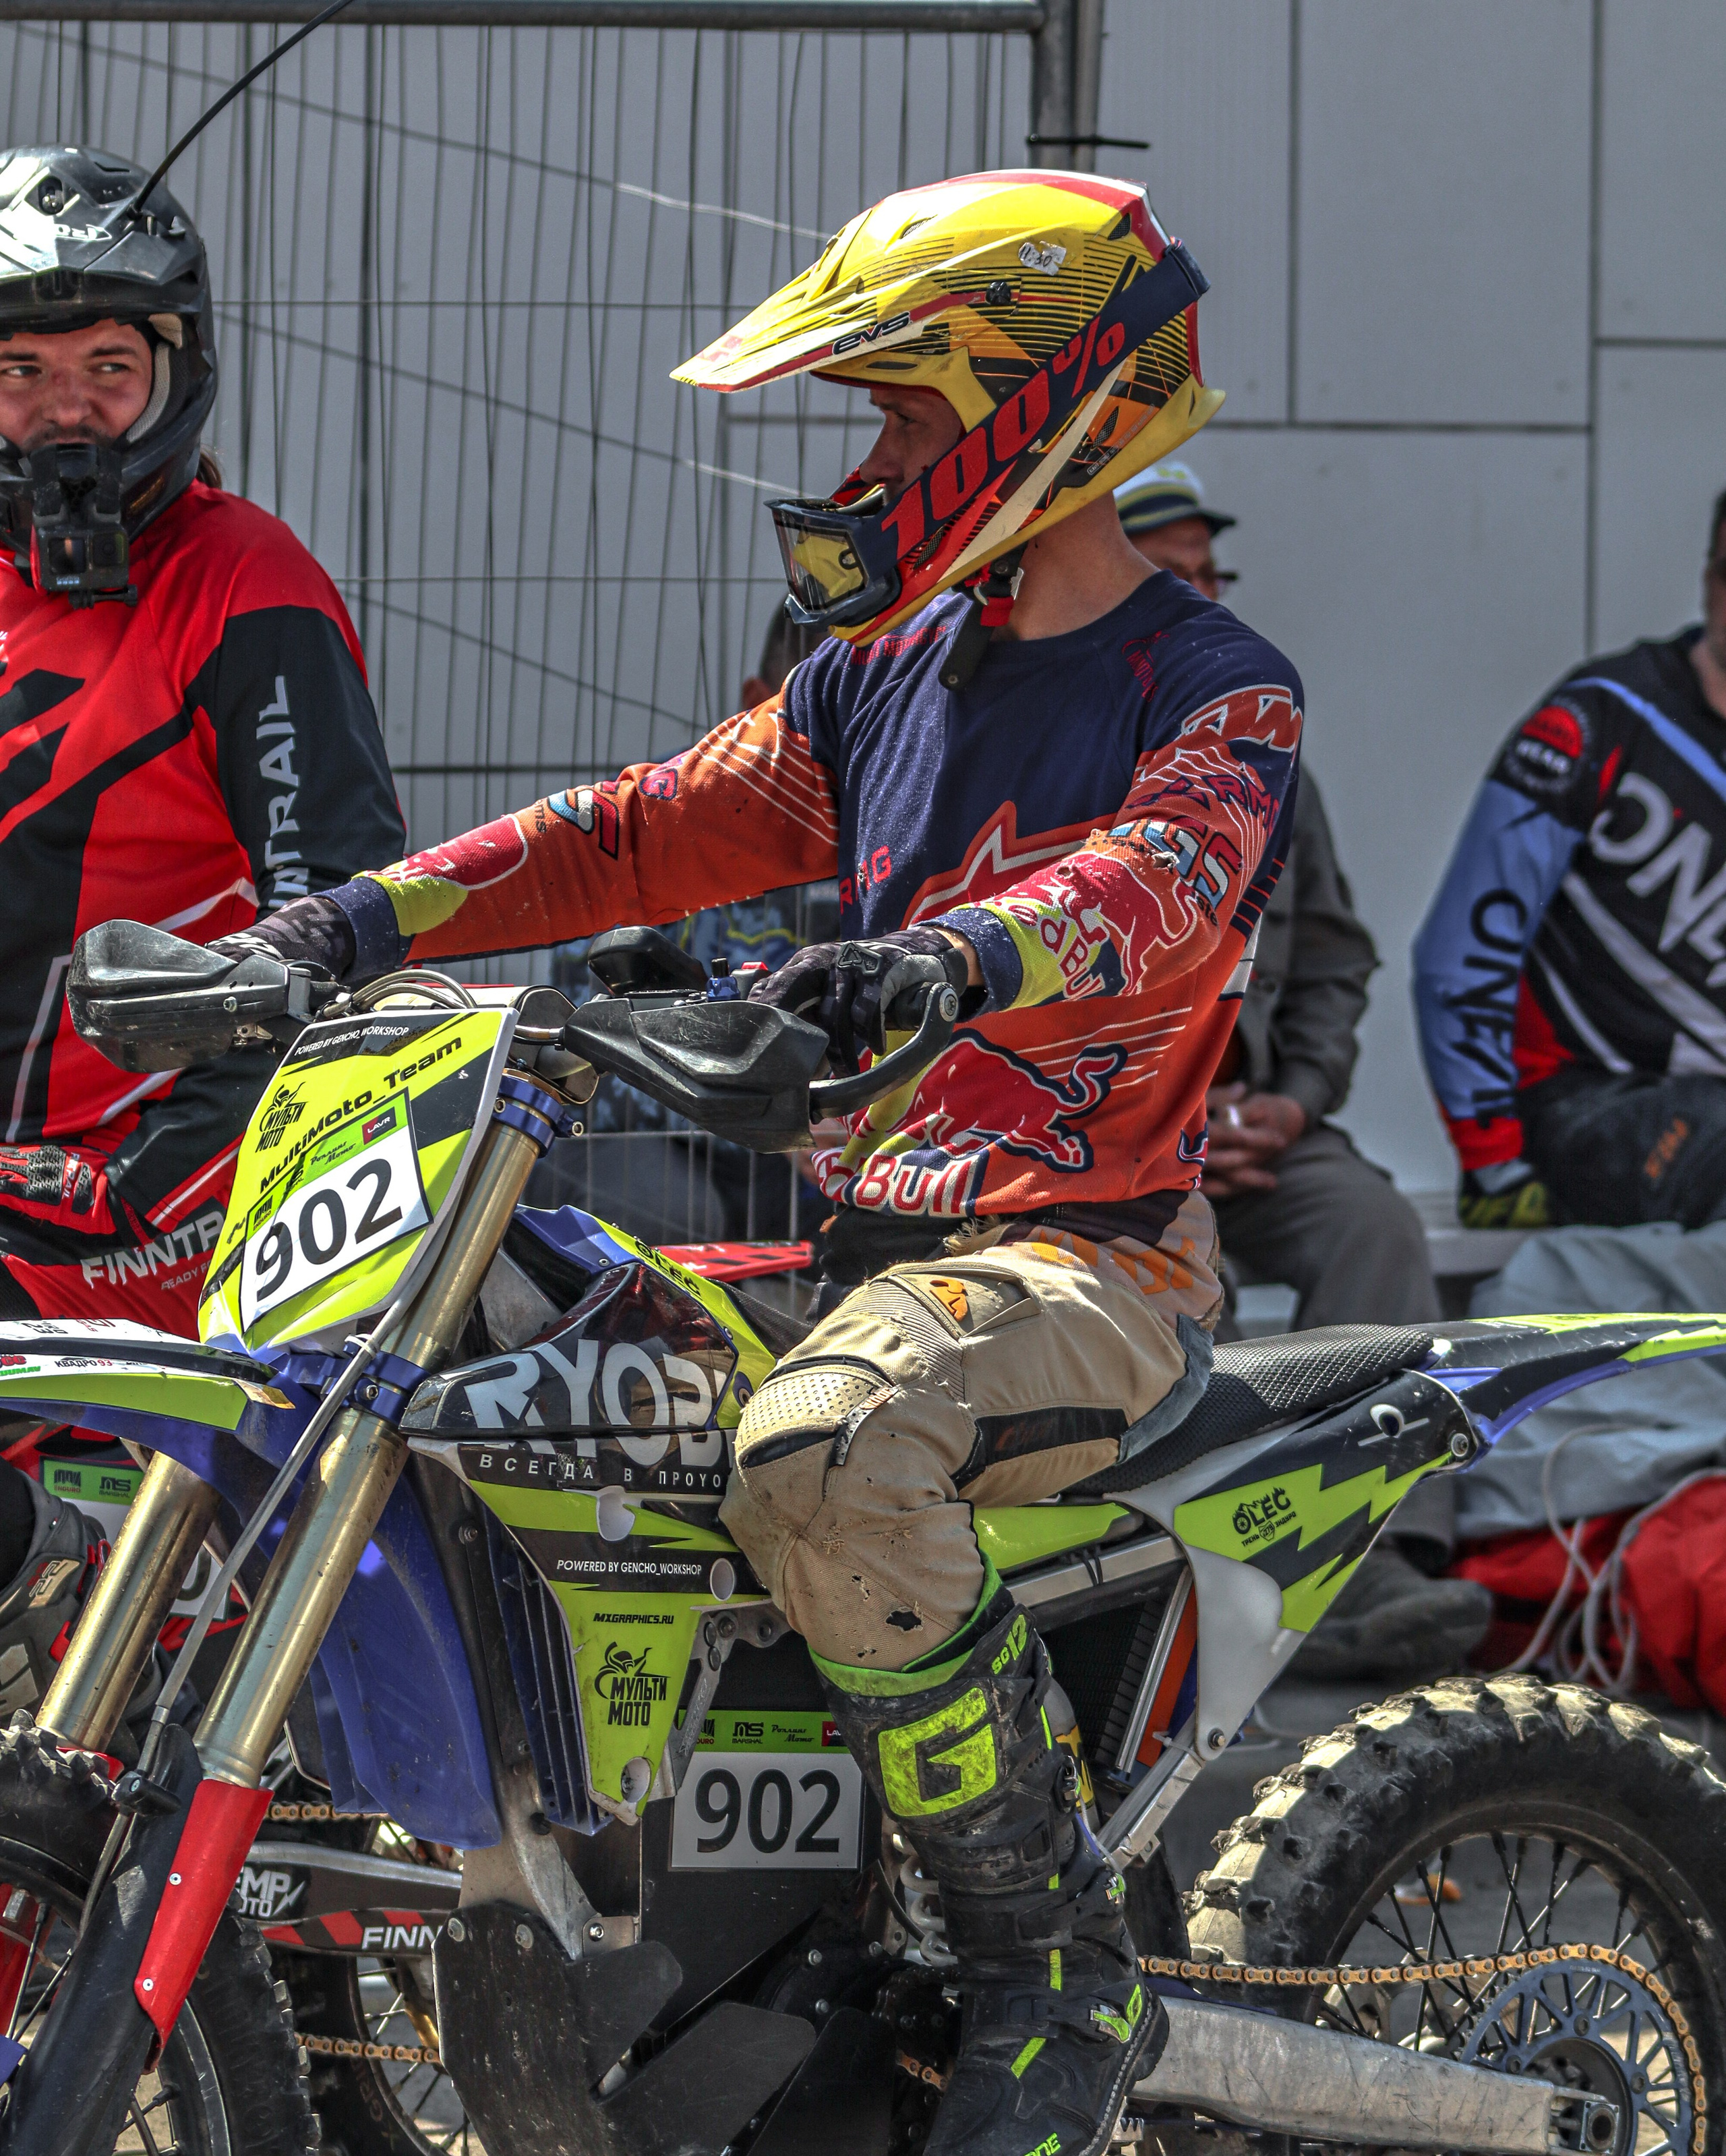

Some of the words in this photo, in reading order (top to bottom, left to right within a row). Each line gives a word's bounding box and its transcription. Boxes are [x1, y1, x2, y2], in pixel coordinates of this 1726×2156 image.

[881, 317, 1126, 560] 100%
[294, 1041, 322, 1056] POWERED
[322, 1037, 331, 1048] BY
[367, 1116, 390, 1134] LAVR
[855, 1153, 973, 1215] Bull
[256, 1159, 403, 1302] 902
[479, 1453, 593, 1480] ВСЕГДА
[624, 1467, 632, 1482] В
[556, 1559, 605, 1573] POWERED
[606, 1561, 619, 1573] BY
[620, 1562, 703, 1576] GENCHO_WORKSHOP
[593, 1612, 674, 1625] MXGRAPHICS.RU
[610, 1676, 667, 1701] МУЛЬТИ
[607, 1701, 651, 1726] МОТО
[694, 1767, 840, 1853] 902
